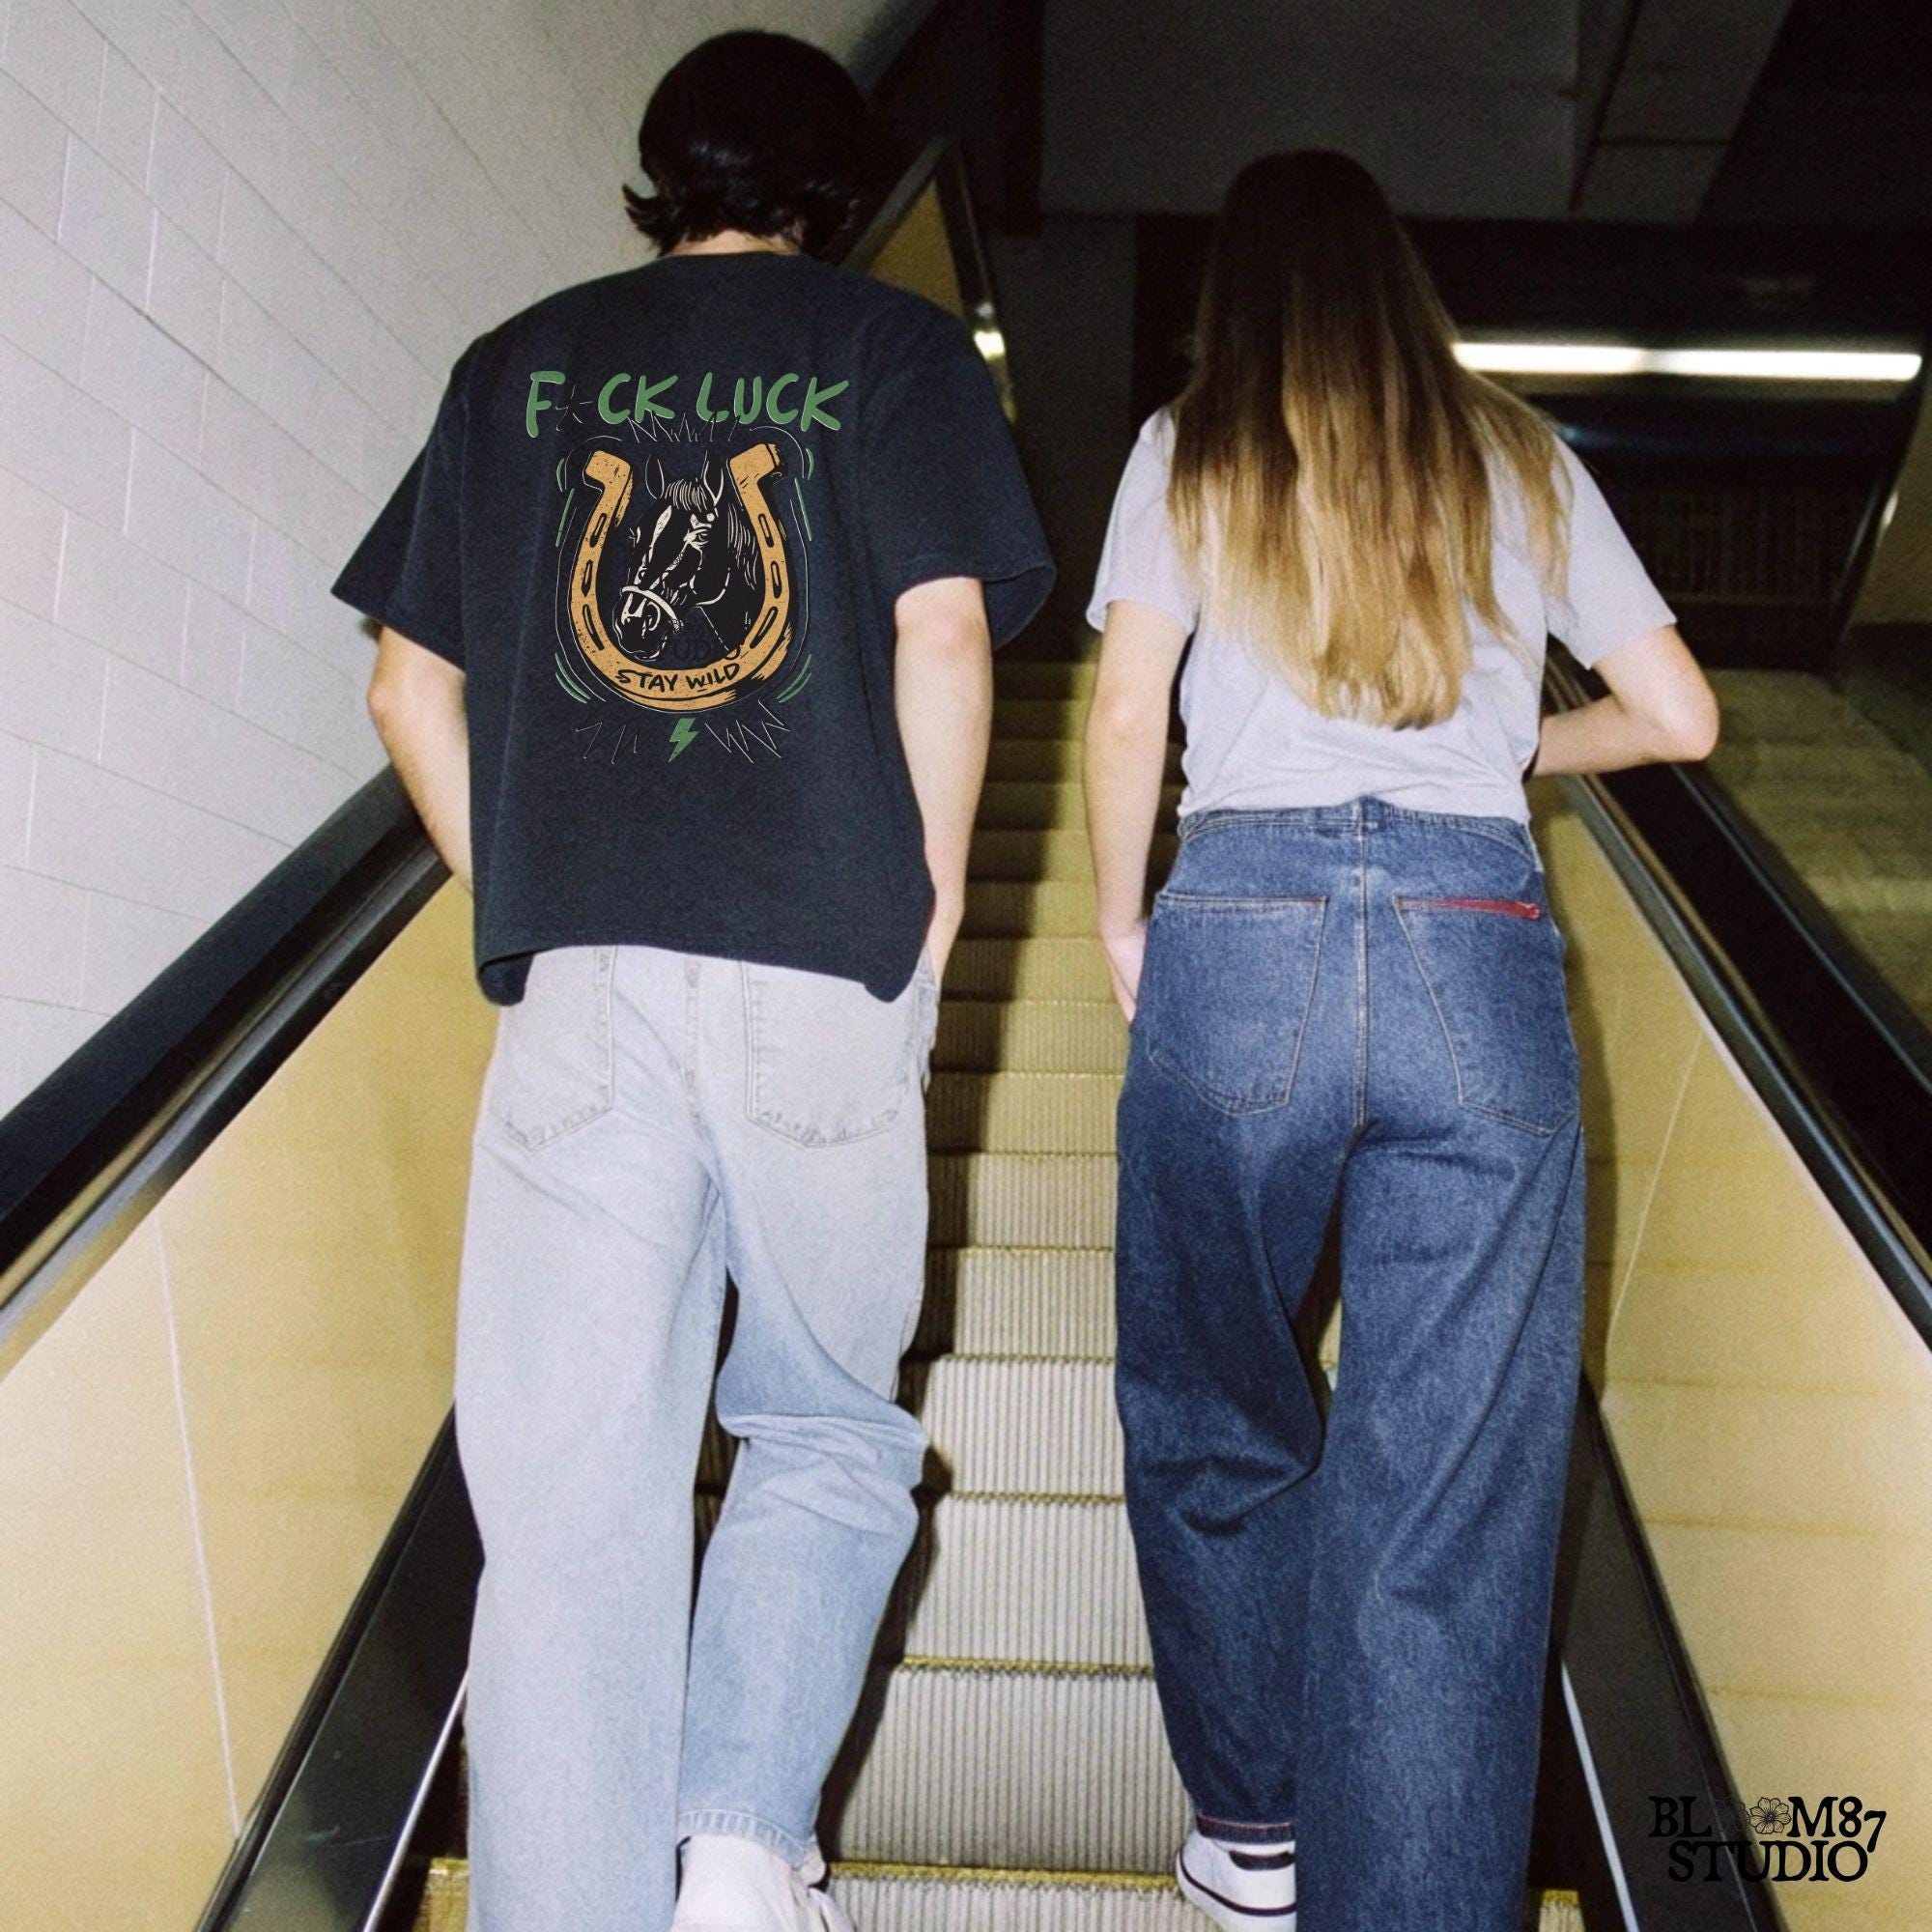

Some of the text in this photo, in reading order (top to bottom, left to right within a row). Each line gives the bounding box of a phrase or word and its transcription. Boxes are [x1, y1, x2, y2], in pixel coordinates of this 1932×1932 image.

[696, 372, 849, 432] LUCK
[615, 663, 740, 693] STAY WILD
